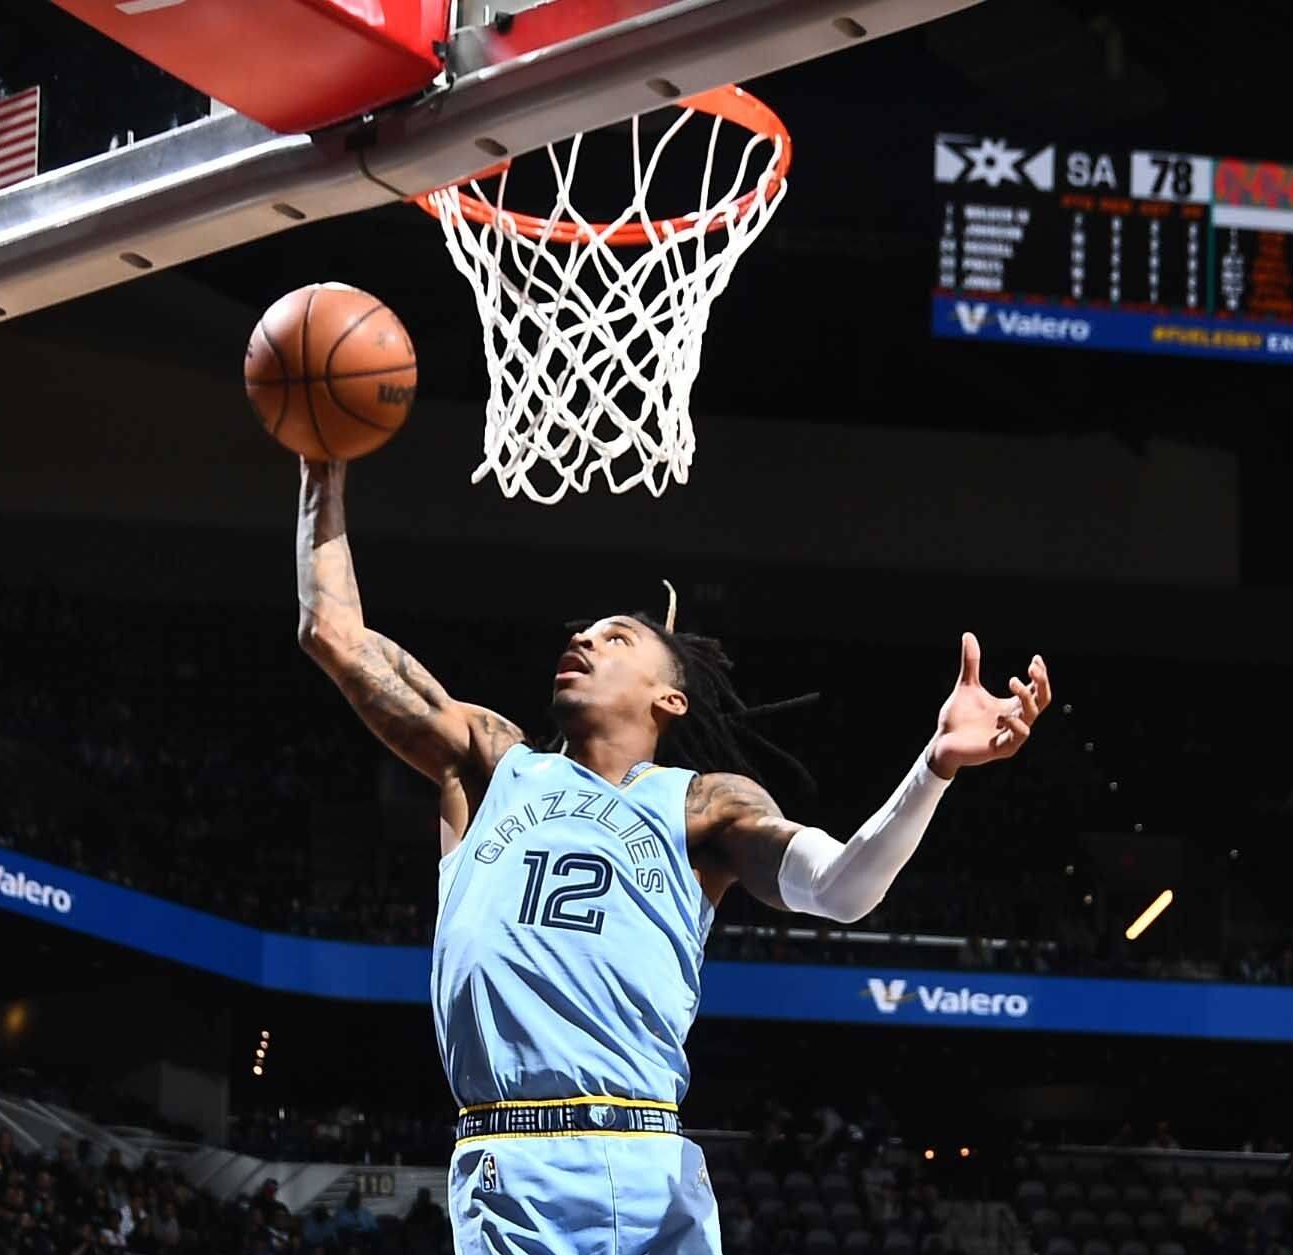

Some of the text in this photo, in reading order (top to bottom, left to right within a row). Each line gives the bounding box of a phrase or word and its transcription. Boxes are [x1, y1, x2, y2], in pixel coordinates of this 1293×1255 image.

[1065, 151, 1118, 188] SA
[1150, 158, 1193, 197] 78
[997, 309, 1091, 341] Valero
[473, 788, 665, 895] GRIZZLIES
[517, 848, 615, 936] 12
[916, 984, 1029, 1018] Valero
